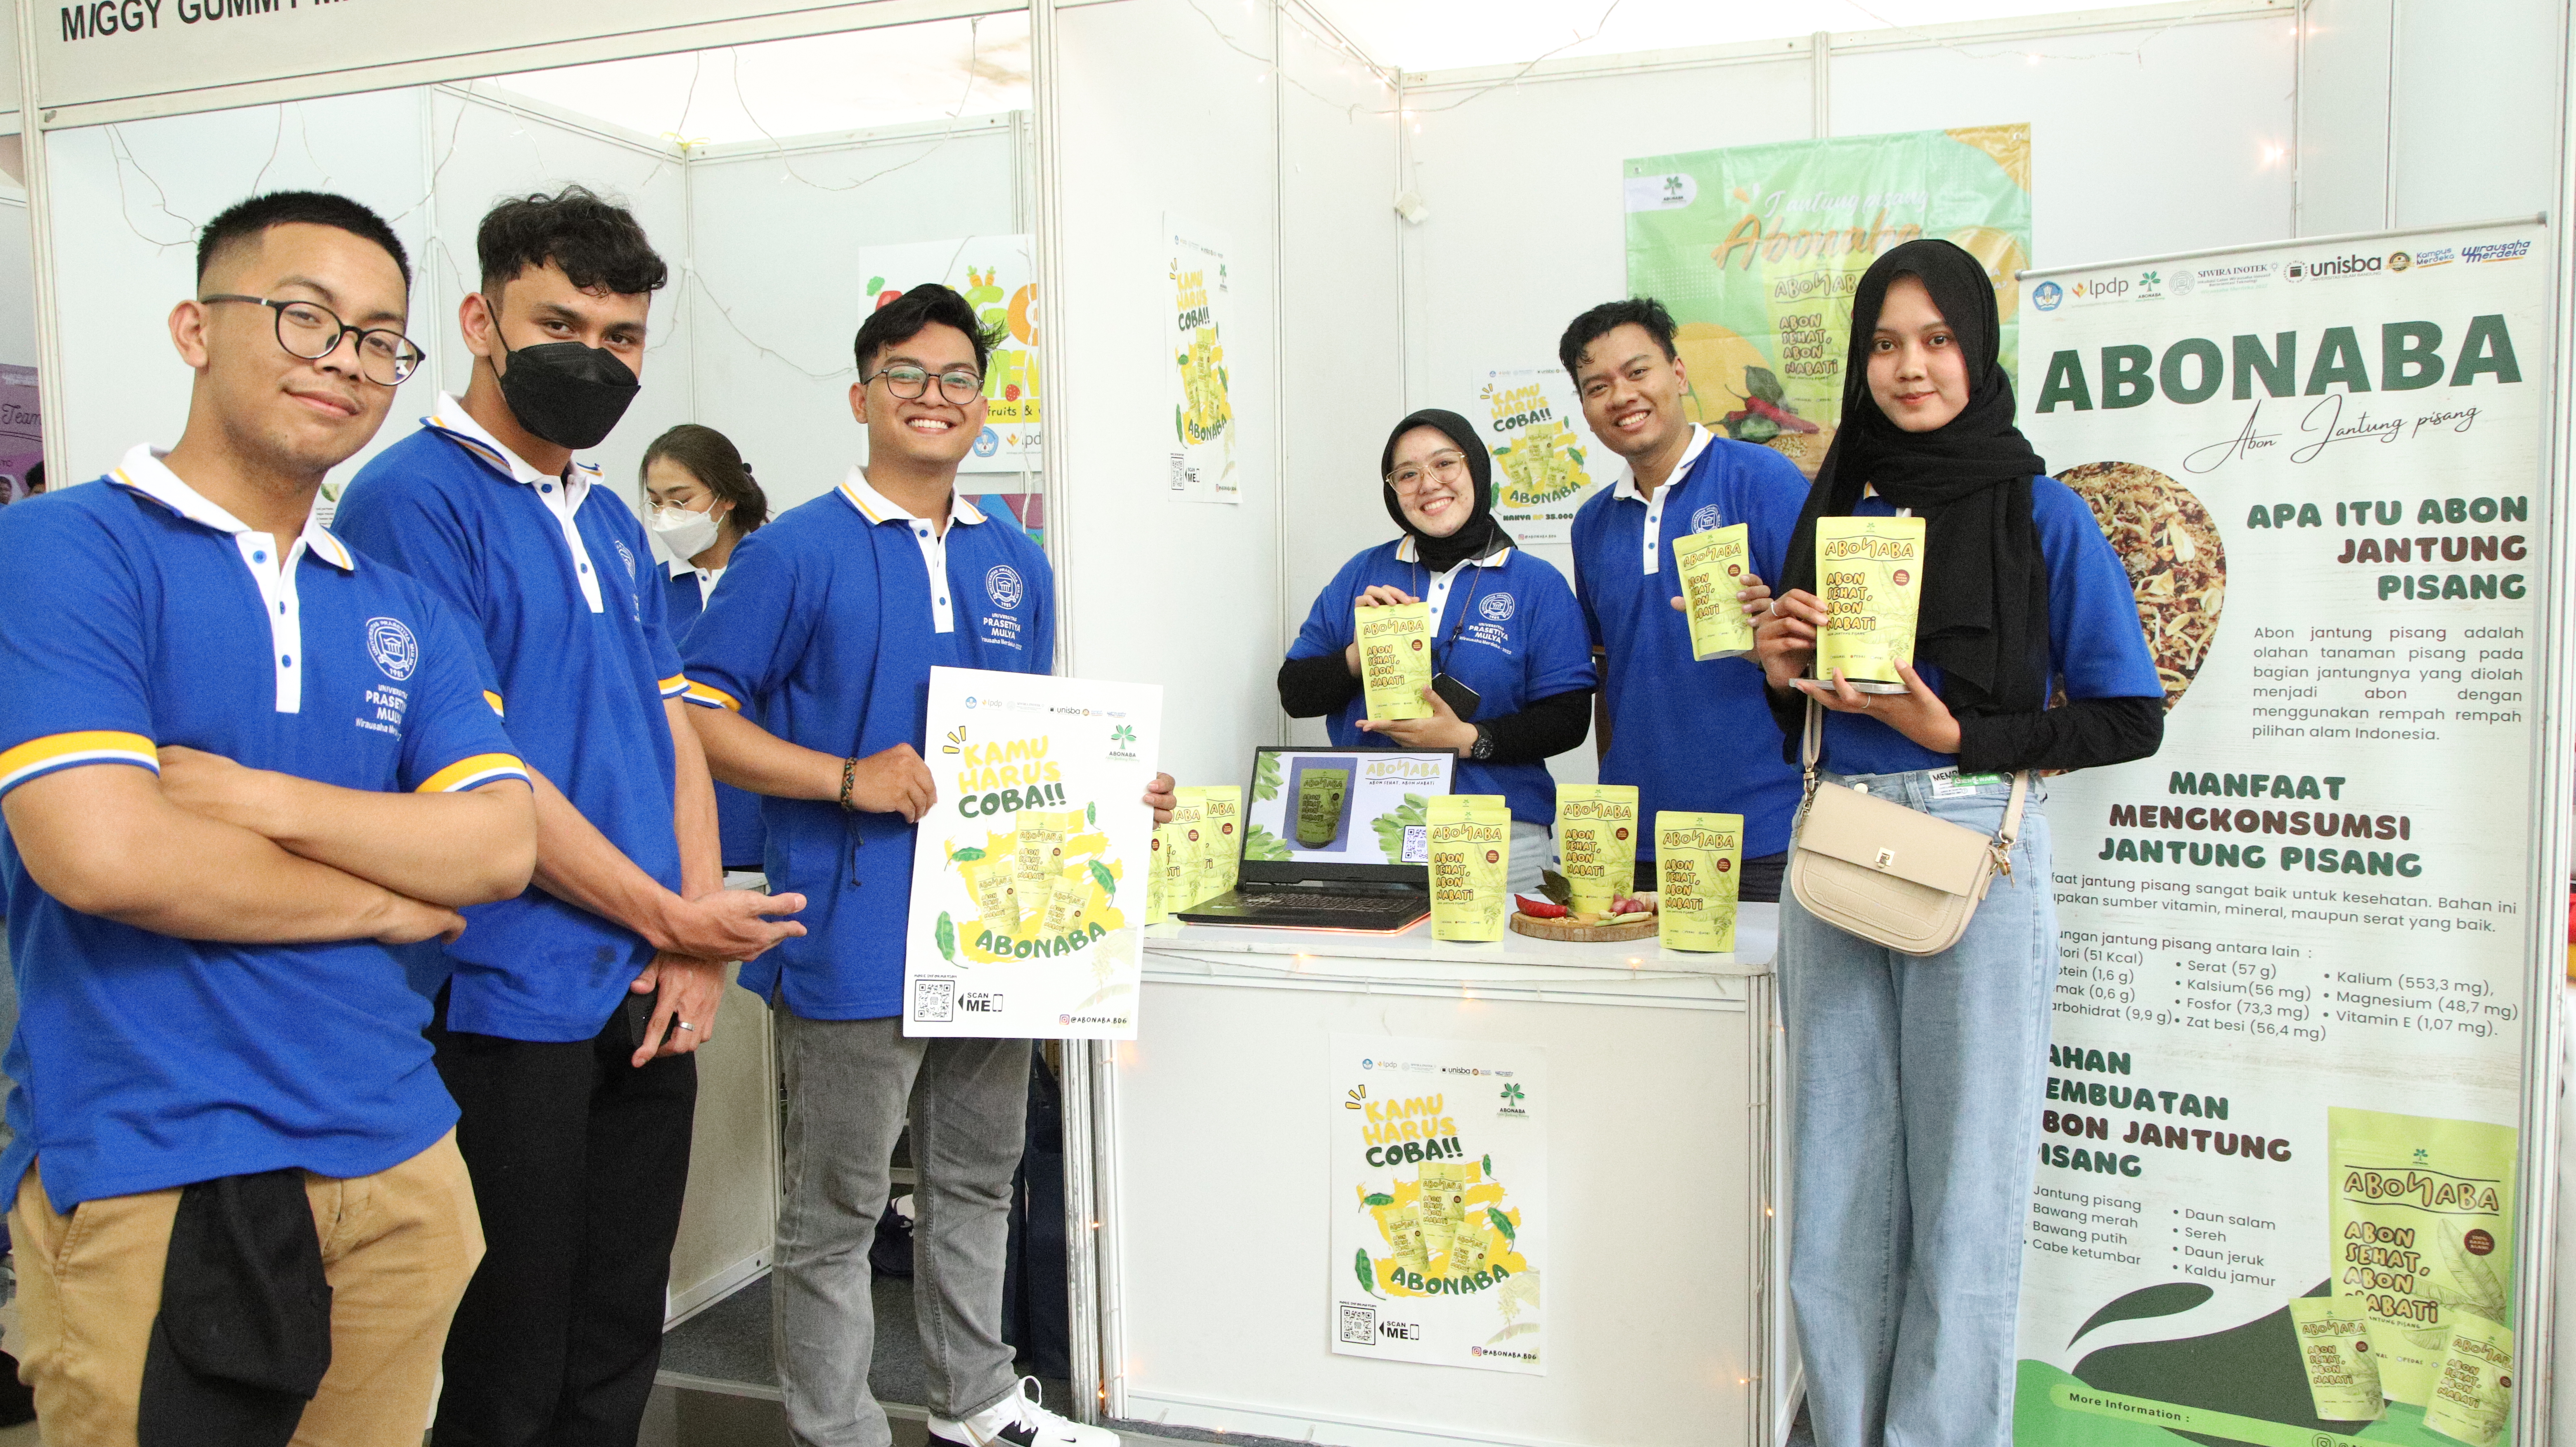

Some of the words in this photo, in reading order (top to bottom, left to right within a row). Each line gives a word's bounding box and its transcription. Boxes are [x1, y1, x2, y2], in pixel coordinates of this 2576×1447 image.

[61, 0, 163, 42] MIGGY
[2311, 254, 2381, 275] unisba
[2417, 249, 2451, 259] Kampus
[2417, 254, 2454, 266] Merdeka
[1177, 269, 1203, 292] KAMU
[2198, 268, 2231, 279] SIWIRA
[2234, 264, 2267, 274] INOTEK
[2090, 278, 2129, 298] lpdp
[1177, 289, 1208, 312] HARUS
[1179, 306, 1210, 331] COBA!!
[1780, 313, 1821, 330] ABON
[1783, 344, 1823, 360] ABON
[2036, 314, 2522, 415] ABONABA
[1492, 384, 1540, 405] KAMU
[988, 406, 1016, 416] fruits
[1491, 396, 1548, 419] HARUS
[1188, 413, 1226, 441] ABONABA
[1493, 408, 1552, 432] COBA!!
[2184, 399, 2282, 473] Abon
[2290, 395, 2407, 463] Jantung
[2412, 406, 2482, 437] pisang
[1188, 474, 1196, 482] ME
[1510, 481, 1581, 504] ABONABA
[2247, 503, 2322, 529] APA
[2337, 501, 2401, 527] ITU
[2417, 496, 2527, 524] ABON
[1825, 537, 1913, 558] ABONABA
[2338, 535, 2527, 563] JANTUNG
[1827, 572, 1865, 586] ABON
[2378, 574, 2526, 600] PISANG
[992, 613, 1017, 621] UNIVERSITAS
[1827, 601, 1863, 615] ABON
[983, 617, 1021, 632] PRASETIYA
[991, 628, 1016, 639] MULYA
[1469, 625, 1508, 640] PRASETIYA
[1478, 622, 1504, 631] UNIVERSITAS
[2254, 627, 2294, 638] Abon
[2310, 627, 2372, 642] jantung
[2390, 626, 2446, 642] pisang
[2465, 627, 2523, 638] adalah
[1475, 632, 1501, 643] MULYA
[2254, 647, 2308, 657] olahan
[2321, 648, 2395, 658] tanaman
[2409, 647, 2465, 662] pisang
[2480, 648, 2523, 662] pada
[2254, 666, 2308, 681] bagian
[2317, 667, 2410, 682] jantungnya
[2420, 670, 2461, 683] yang
[2471, 668, 2522, 680] diolah
[2254, 686, 2317, 700] menjadi
[2365, 688, 2406, 699] abon
[2458, 689, 2522, 705] dengan
[1056, 706, 1080, 715] unisba
[2253, 707, 2368, 721] menggunakan
[2379, 709, 2444, 723] rempah
[2456, 711, 2521, 724] rempah
[2253, 725, 2304, 739] pilihan
[2310, 726, 2350, 738] alam
[2356, 728, 2439, 740] Indonesia.
[964, 735, 1049, 769] KAMU
[958, 761, 1061, 794] HARUS
[1366, 759, 1440, 777] ABONABA
[2169, 771, 2345, 800] MANFAAT
[958, 783, 1066, 818] COBA!!
[1433, 822, 1501, 841] ABONABA
[2108, 804, 2410, 841] MENGKONSUMSI
[1663, 830, 1733, 848] ABONABA
[1435, 853, 1463, 863] ABON
[1665, 859, 1693, 871] ABON
[2098, 838, 2266, 868] JANTUNG
[2281, 847, 2422, 877] PISANG
[1436, 877, 1463, 888] ABON
[1665, 884, 1692, 896] ABON
[975, 922, 1106, 958] ABONABA
[2188, 961, 2226, 973] Serat
[2232, 961, 2254, 976] (57
[2260, 964, 2276, 980] g)
[2188, 979, 2273, 996] Kalsium(56
[2279, 986, 2311, 1002] mg)
[2338, 972, 2391, 986] Kalium
[2398, 974, 2448, 991] (553,3
[2455, 980, 2493, 996] mg),
[966, 1001, 990, 1011] ME
[2337, 991, 2431, 1009] Magnesium
[2439, 996, 2479, 1013] (48,7
[2485, 1004, 2518, 1020] mg)
[2337, 1011, 2398, 1026] Vitamin
[2404, 1017, 2410, 1027] E
[2417, 1015, 2453, 1031] (1,07
[2459, 1020, 2498, 1037] mg).
[2050, 1044, 2131, 1075] AHAN
[1364, 1093, 1443, 1123] KAMU
[2046, 1077, 2228, 1120] EMBUATAN
[1363, 1117, 1456, 1146] HARUS
[2043, 1110, 2107, 1140] BON
[2123, 1121, 2292, 1162] JANTUNG
[1366, 1137, 1463, 1167] COBA!!
[2037, 1143, 2142, 1177] ISANG
[2034, 1186, 2088, 1206] Jantung
[2093, 1195, 2141, 1213] pisang
[2033, 1203, 2087, 1224] Bawang
[2092, 1215, 2138, 1228] merah
[2186, 1209, 2223, 1223] Daun
[2229, 1216, 2275, 1230] salam
[2033, 1221, 2087, 1241] Bawang
[2092, 1233, 2127, 1244] putih
[2185, 1227, 2226, 1242] Sereh
[2033, 1239, 2068, 1254] Cabe
[2072, 1245, 2140, 1264] ketumbar
[2185, 1245, 2223, 1260] Daun
[2227, 1251, 2263, 1266] jeruk
[1390, 1264, 1510, 1295] ABONABA
[2185, 1264, 2226, 1279] Kaldu
[2230, 1270, 2275, 1286] jamur
[1387, 1328, 1408, 1340] ME
[2070, 1393, 2101, 1406] More
[2106, 1400, 2181, 1421] Information
